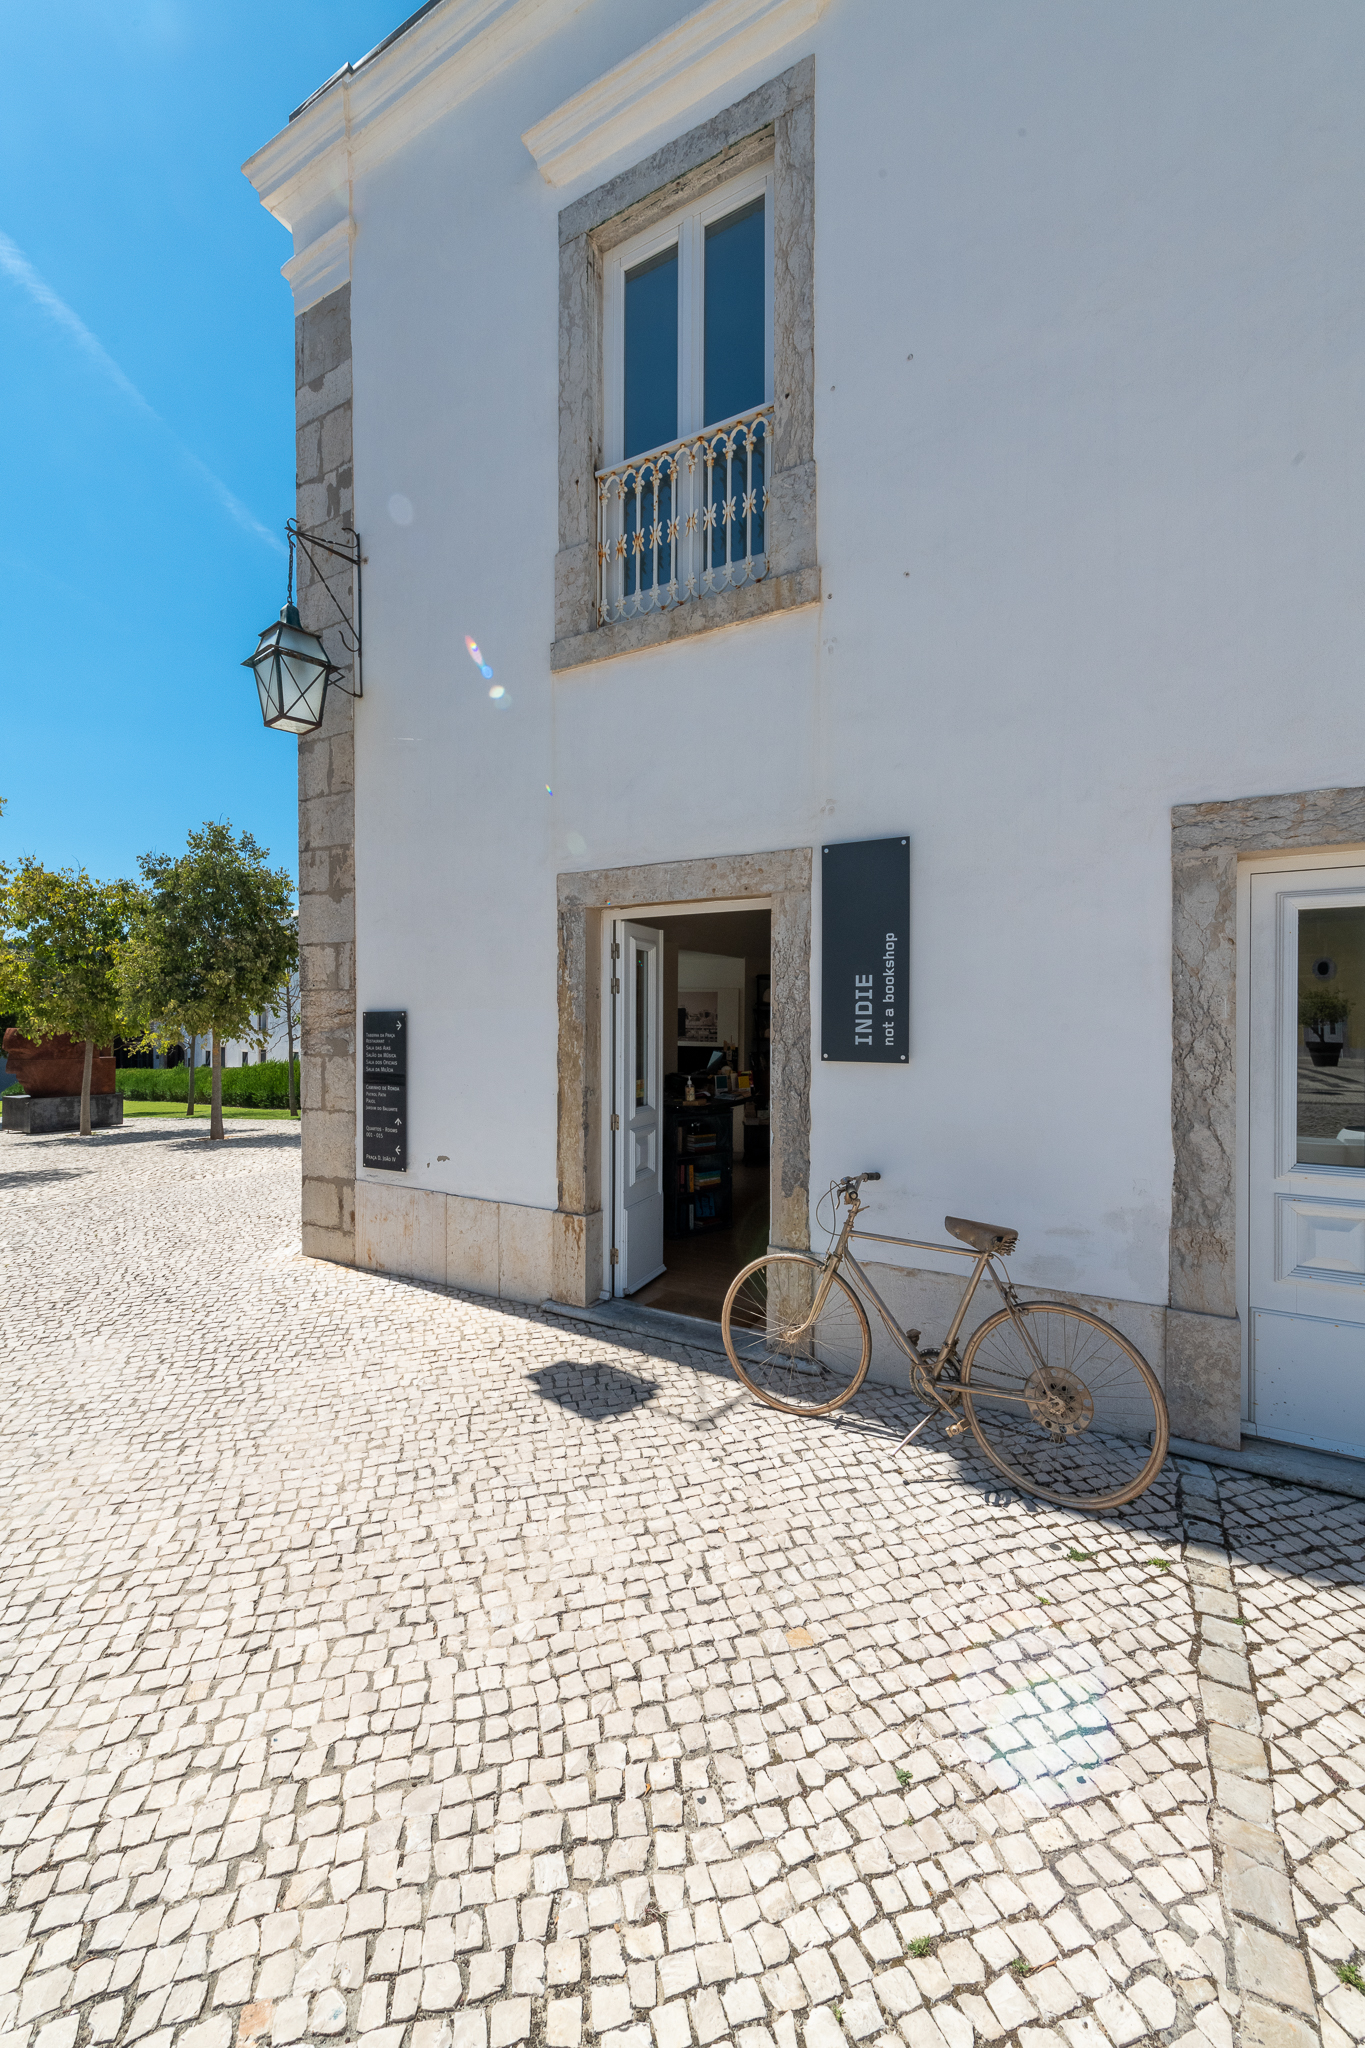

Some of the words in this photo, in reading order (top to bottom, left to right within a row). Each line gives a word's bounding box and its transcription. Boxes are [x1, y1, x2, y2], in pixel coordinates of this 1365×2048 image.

[882, 932, 898, 1003] bookshop
[855, 974, 873, 1046] INDIE
[882, 1021, 895, 1046] not
[885, 1008, 895, 1017] a
